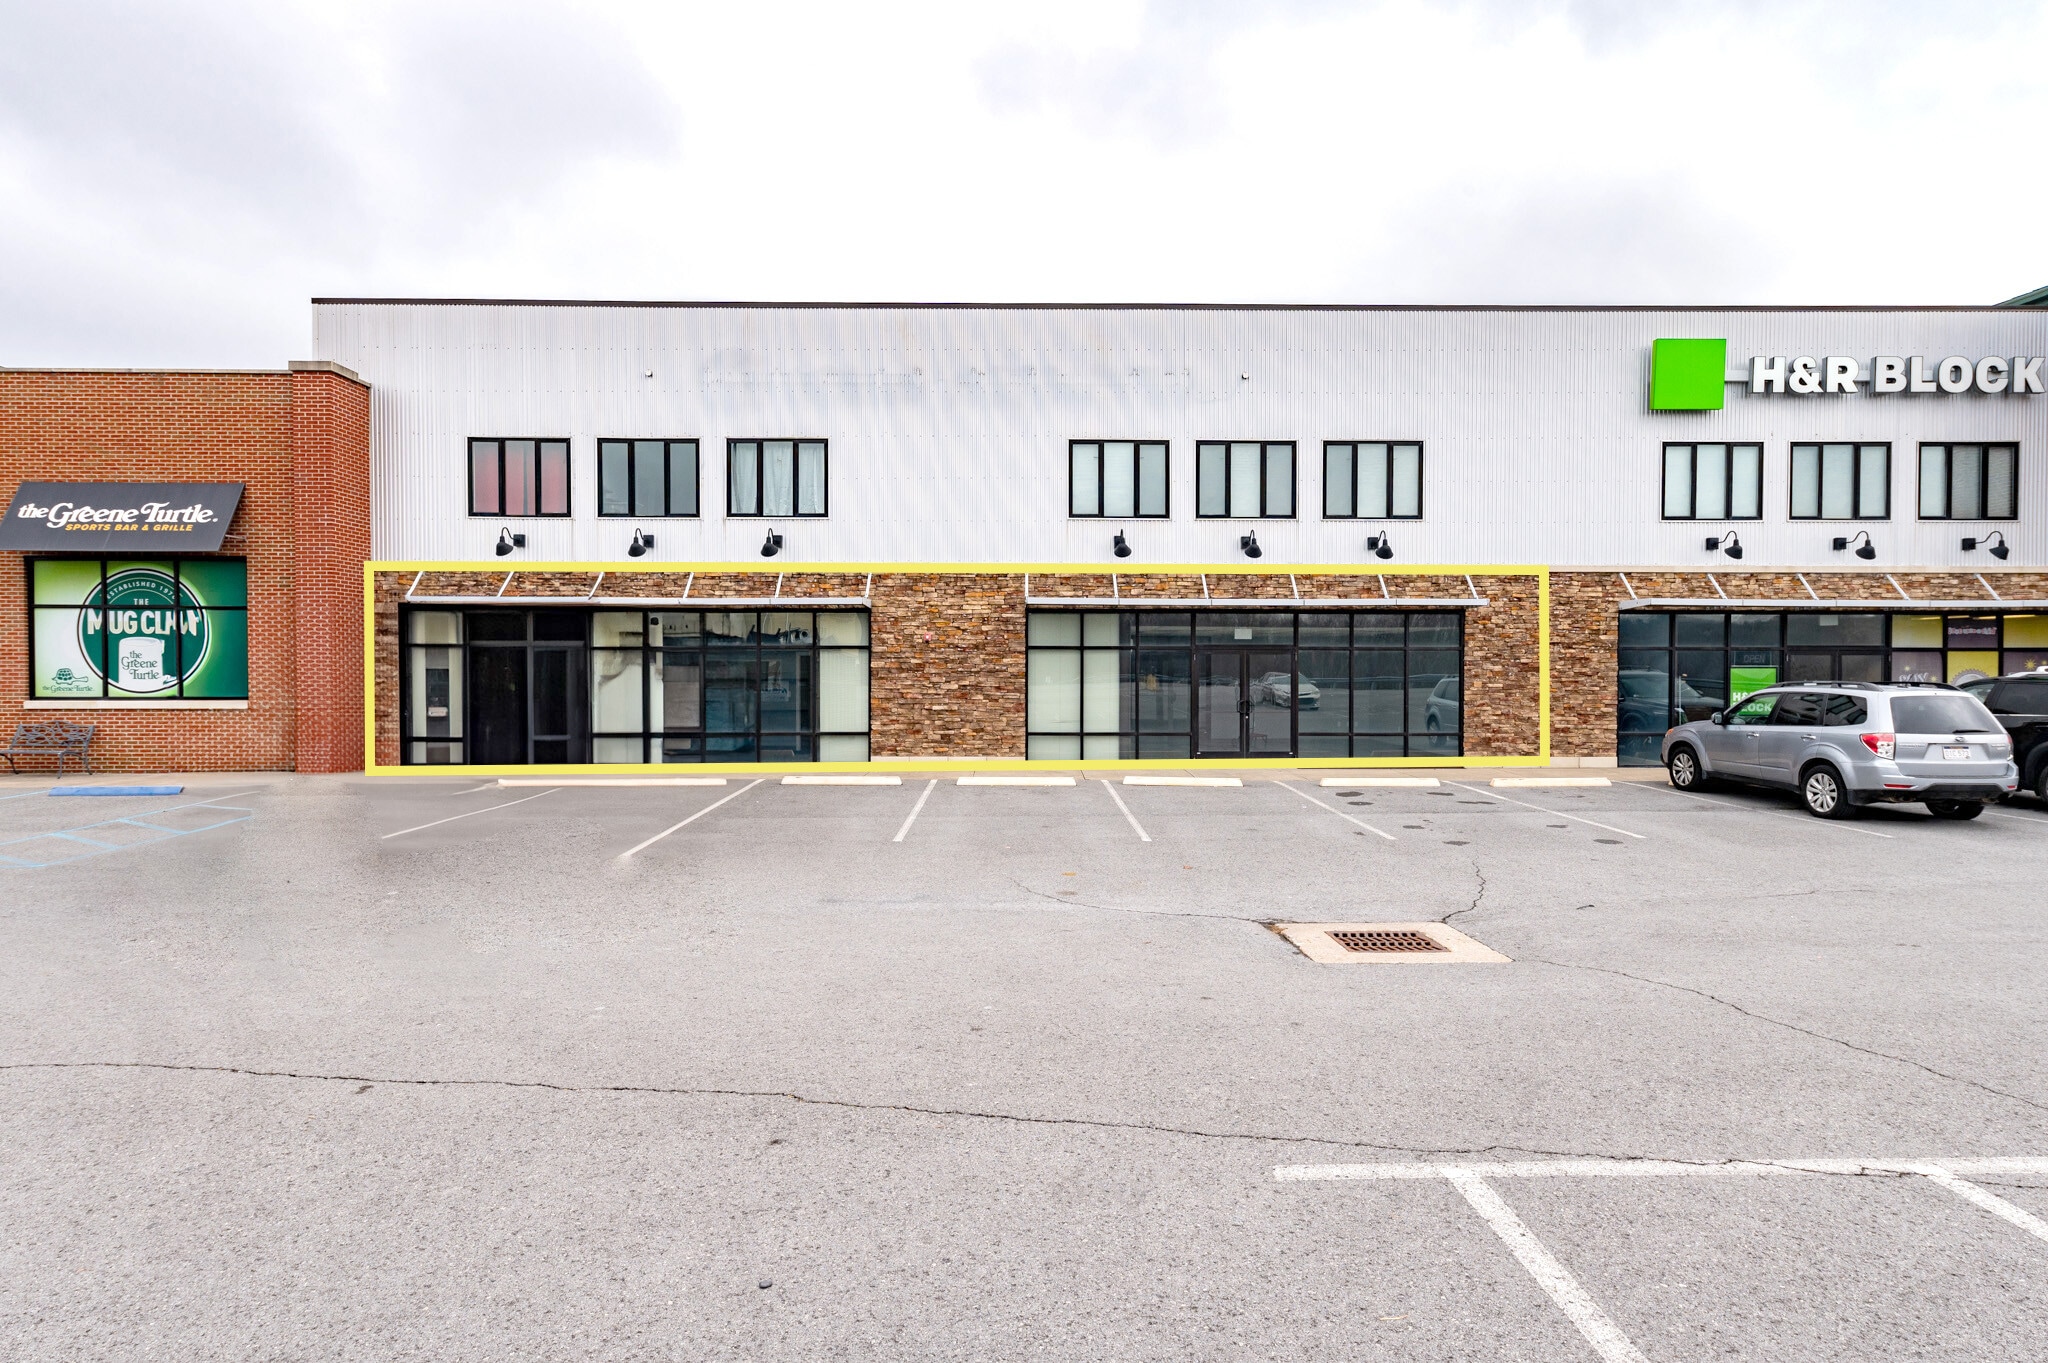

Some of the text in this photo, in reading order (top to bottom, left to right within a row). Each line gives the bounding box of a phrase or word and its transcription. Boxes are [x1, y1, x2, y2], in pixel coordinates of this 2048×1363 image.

[1750, 356, 2046, 395] H&R BLOCK
[17, 503, 49, 519] the
[46, 502, 140, 529] Greene
[65, 523, 111, 531] SPORTS
[153, 524, 194, 532] GRILLE
[107, 581, 156, 599] ESTABLISHED
[133, 598, 150, 606] THE
[87, 608, 138, 635] MUG
[129, 650, 142, 659] the
[121, 656, 158, 671] Greene
[1732, 691, 1753, 702] H&
